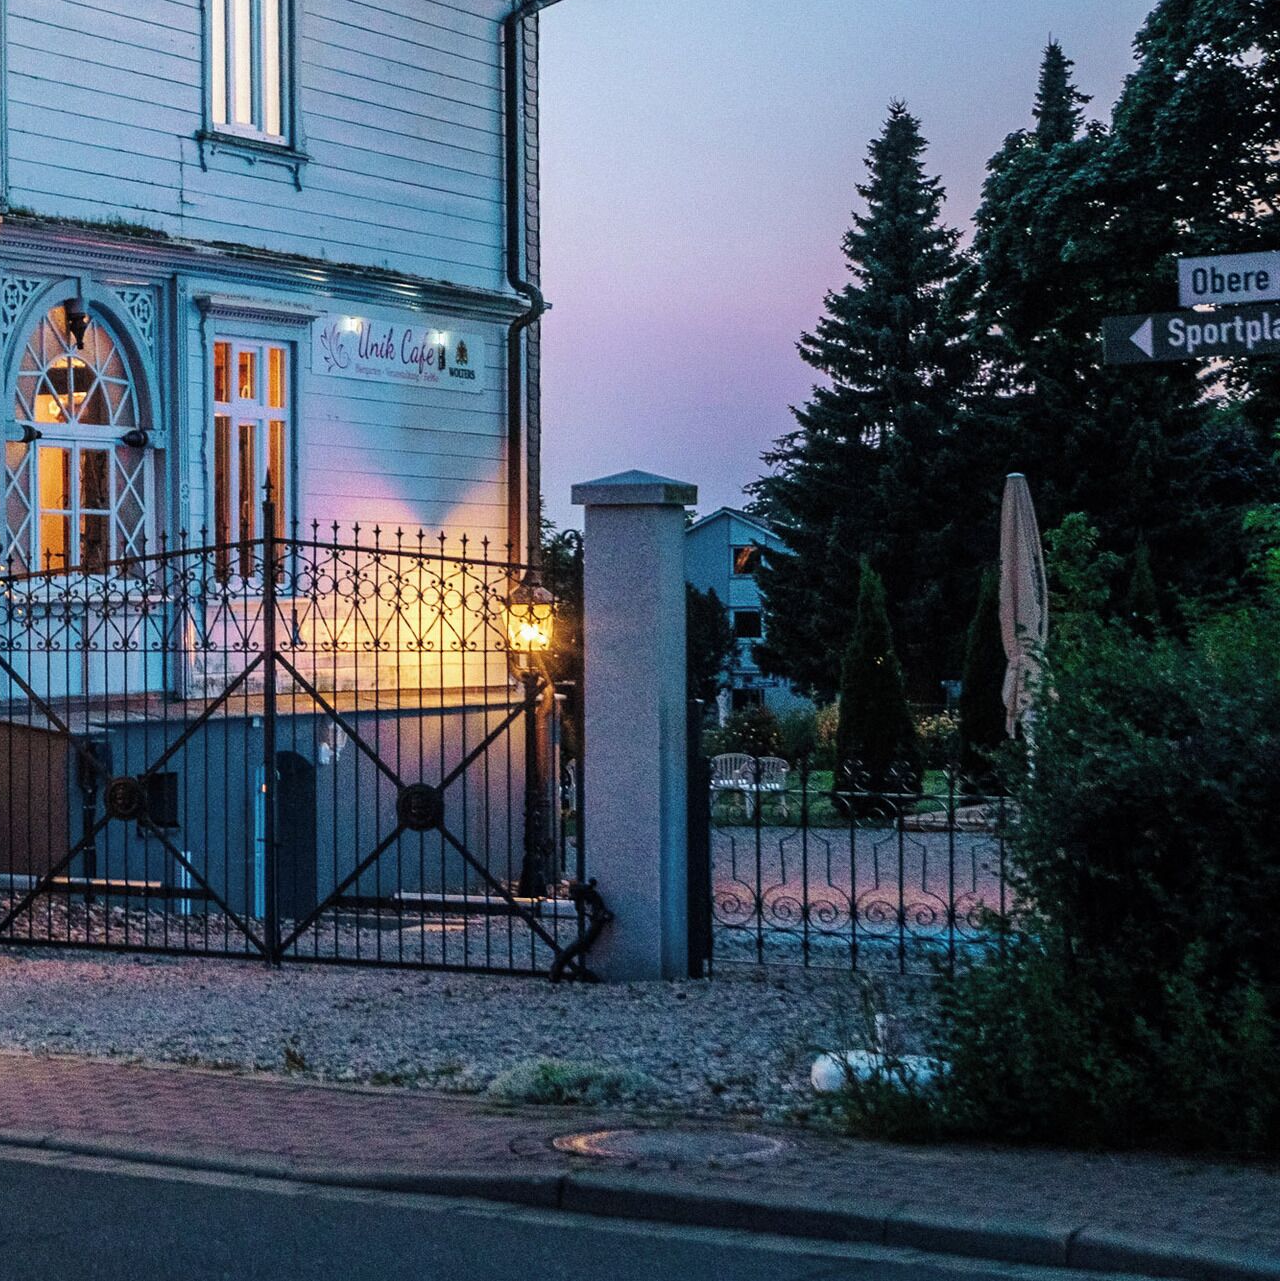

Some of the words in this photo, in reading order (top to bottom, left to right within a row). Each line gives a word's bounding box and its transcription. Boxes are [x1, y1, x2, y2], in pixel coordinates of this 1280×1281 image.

[1192, 266, 1269, 295] Obere
[357, 321, 395, 360] Unik
[449, 367, 475, 380] WOLTERS
